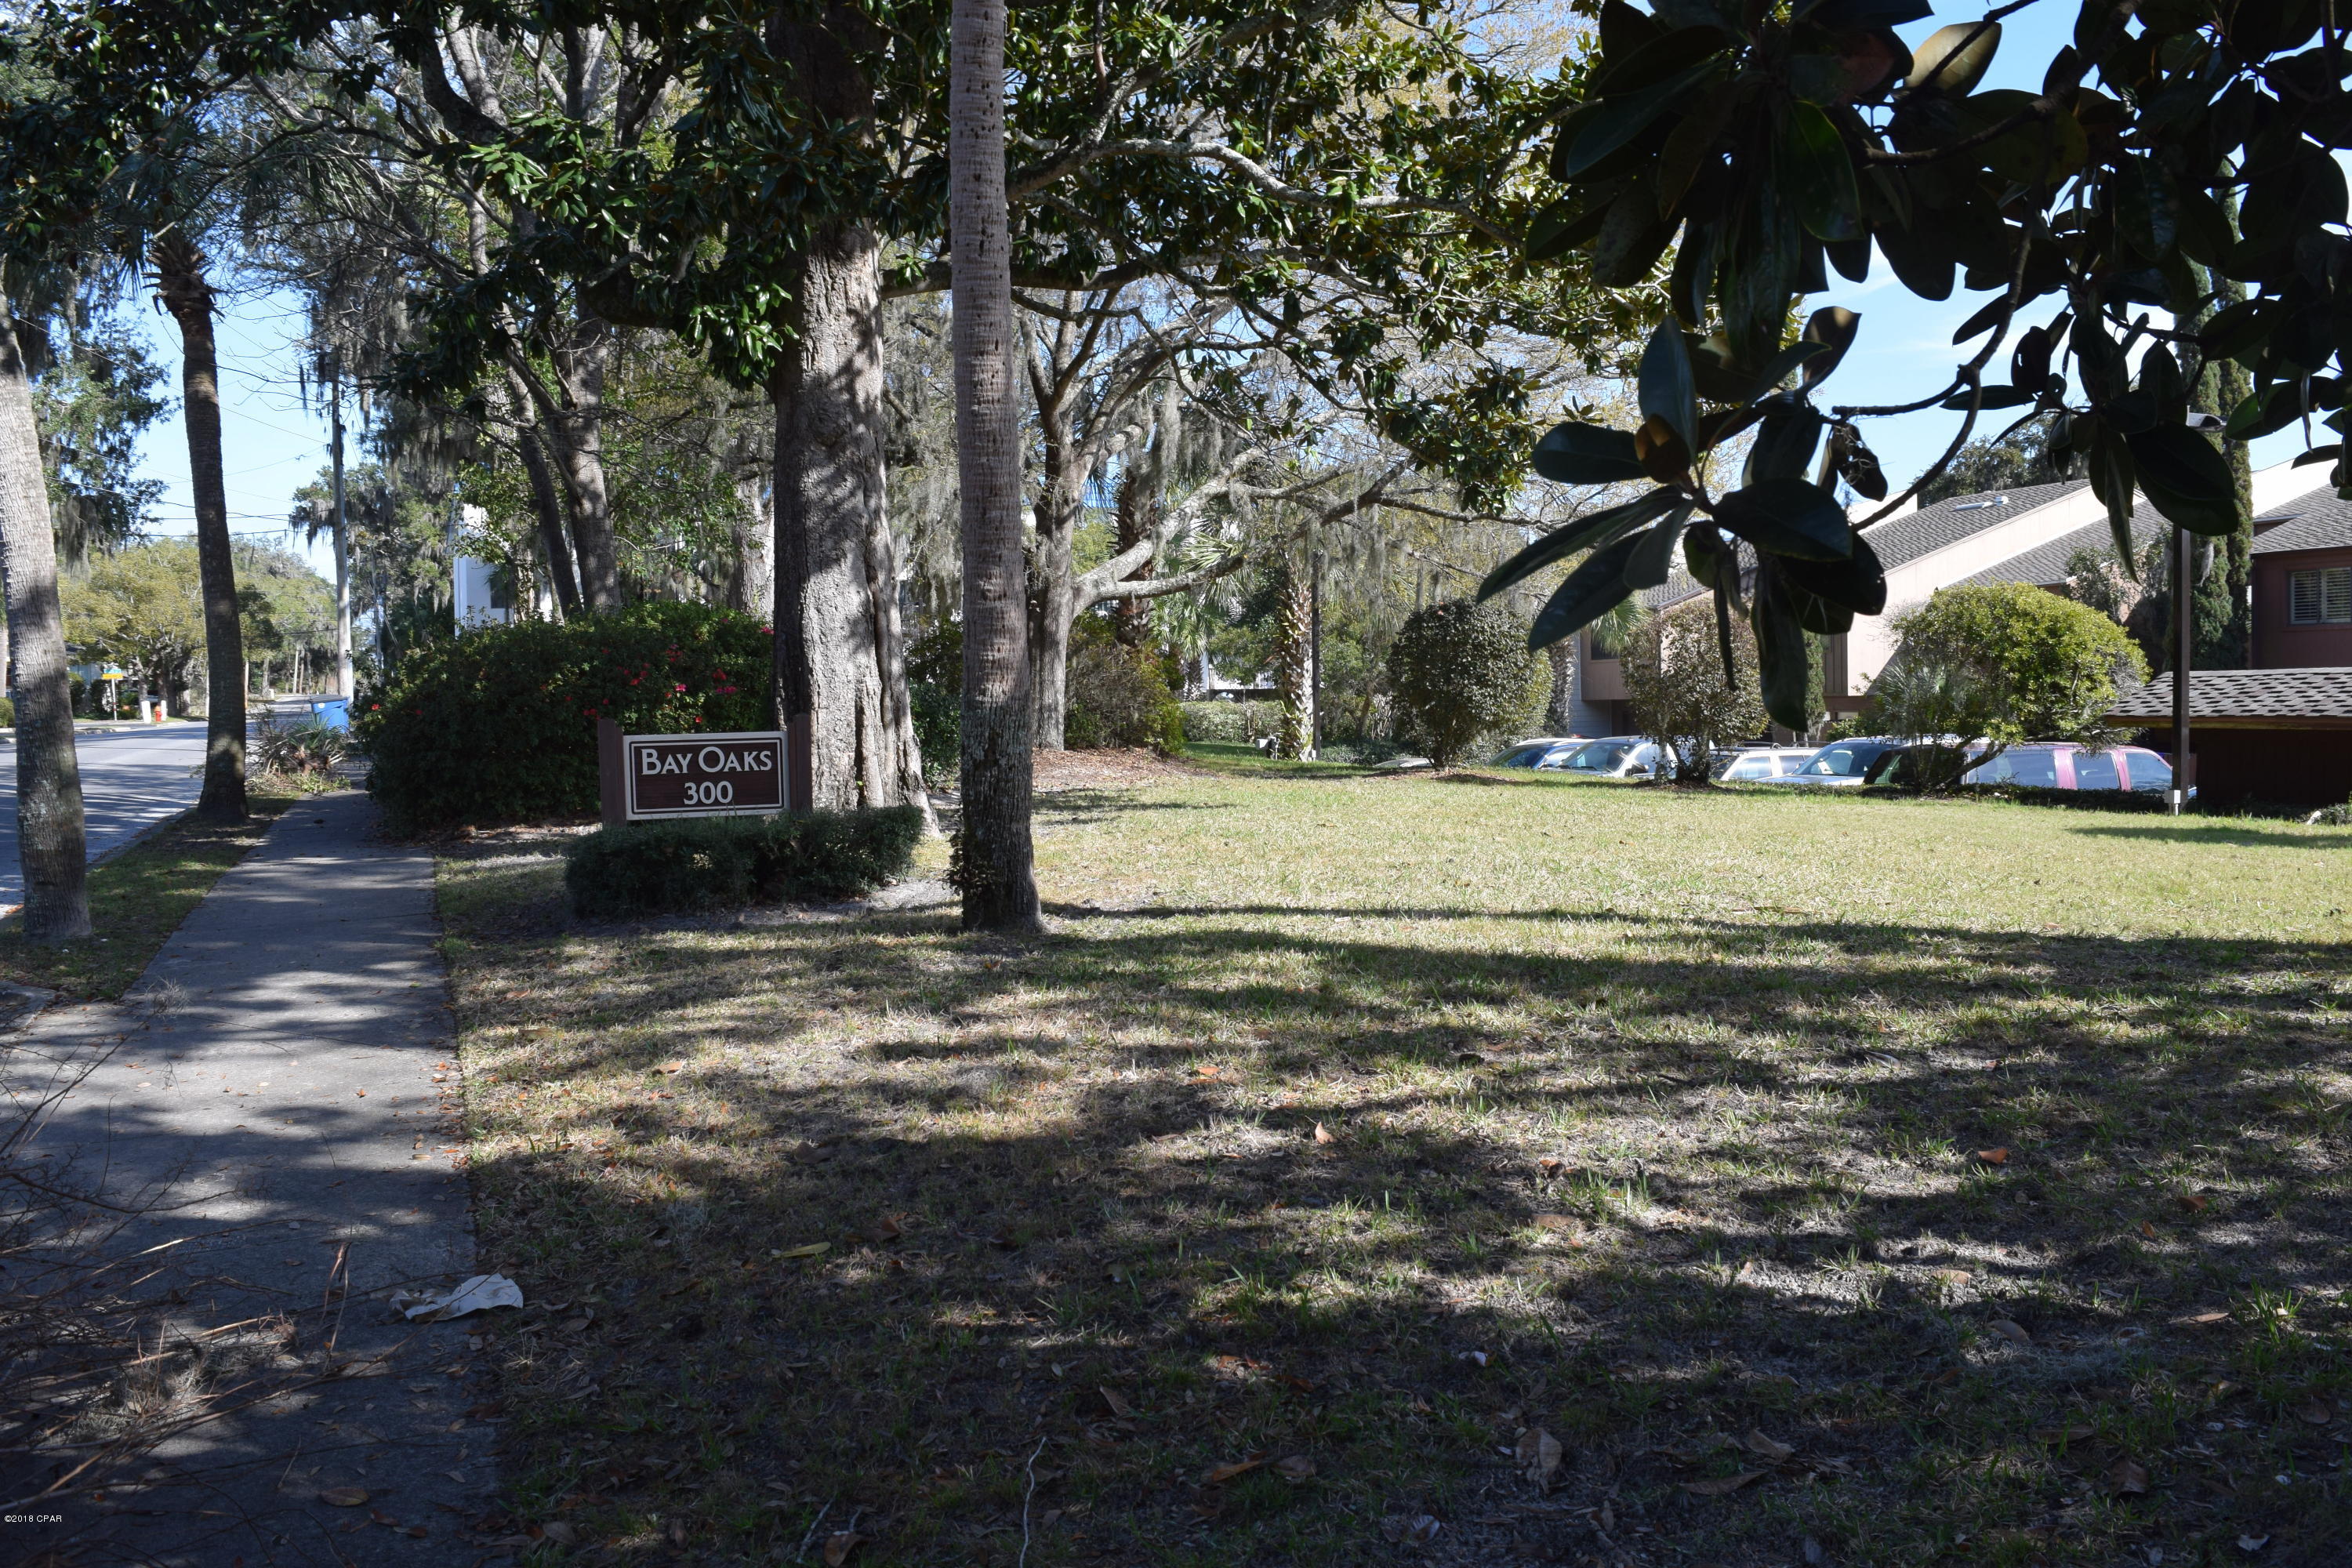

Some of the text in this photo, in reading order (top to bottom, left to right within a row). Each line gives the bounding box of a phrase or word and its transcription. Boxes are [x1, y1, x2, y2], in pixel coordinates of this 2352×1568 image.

[641, 746, 772, 775] BAY OAKS
[684, 781, 733, 804] 300
